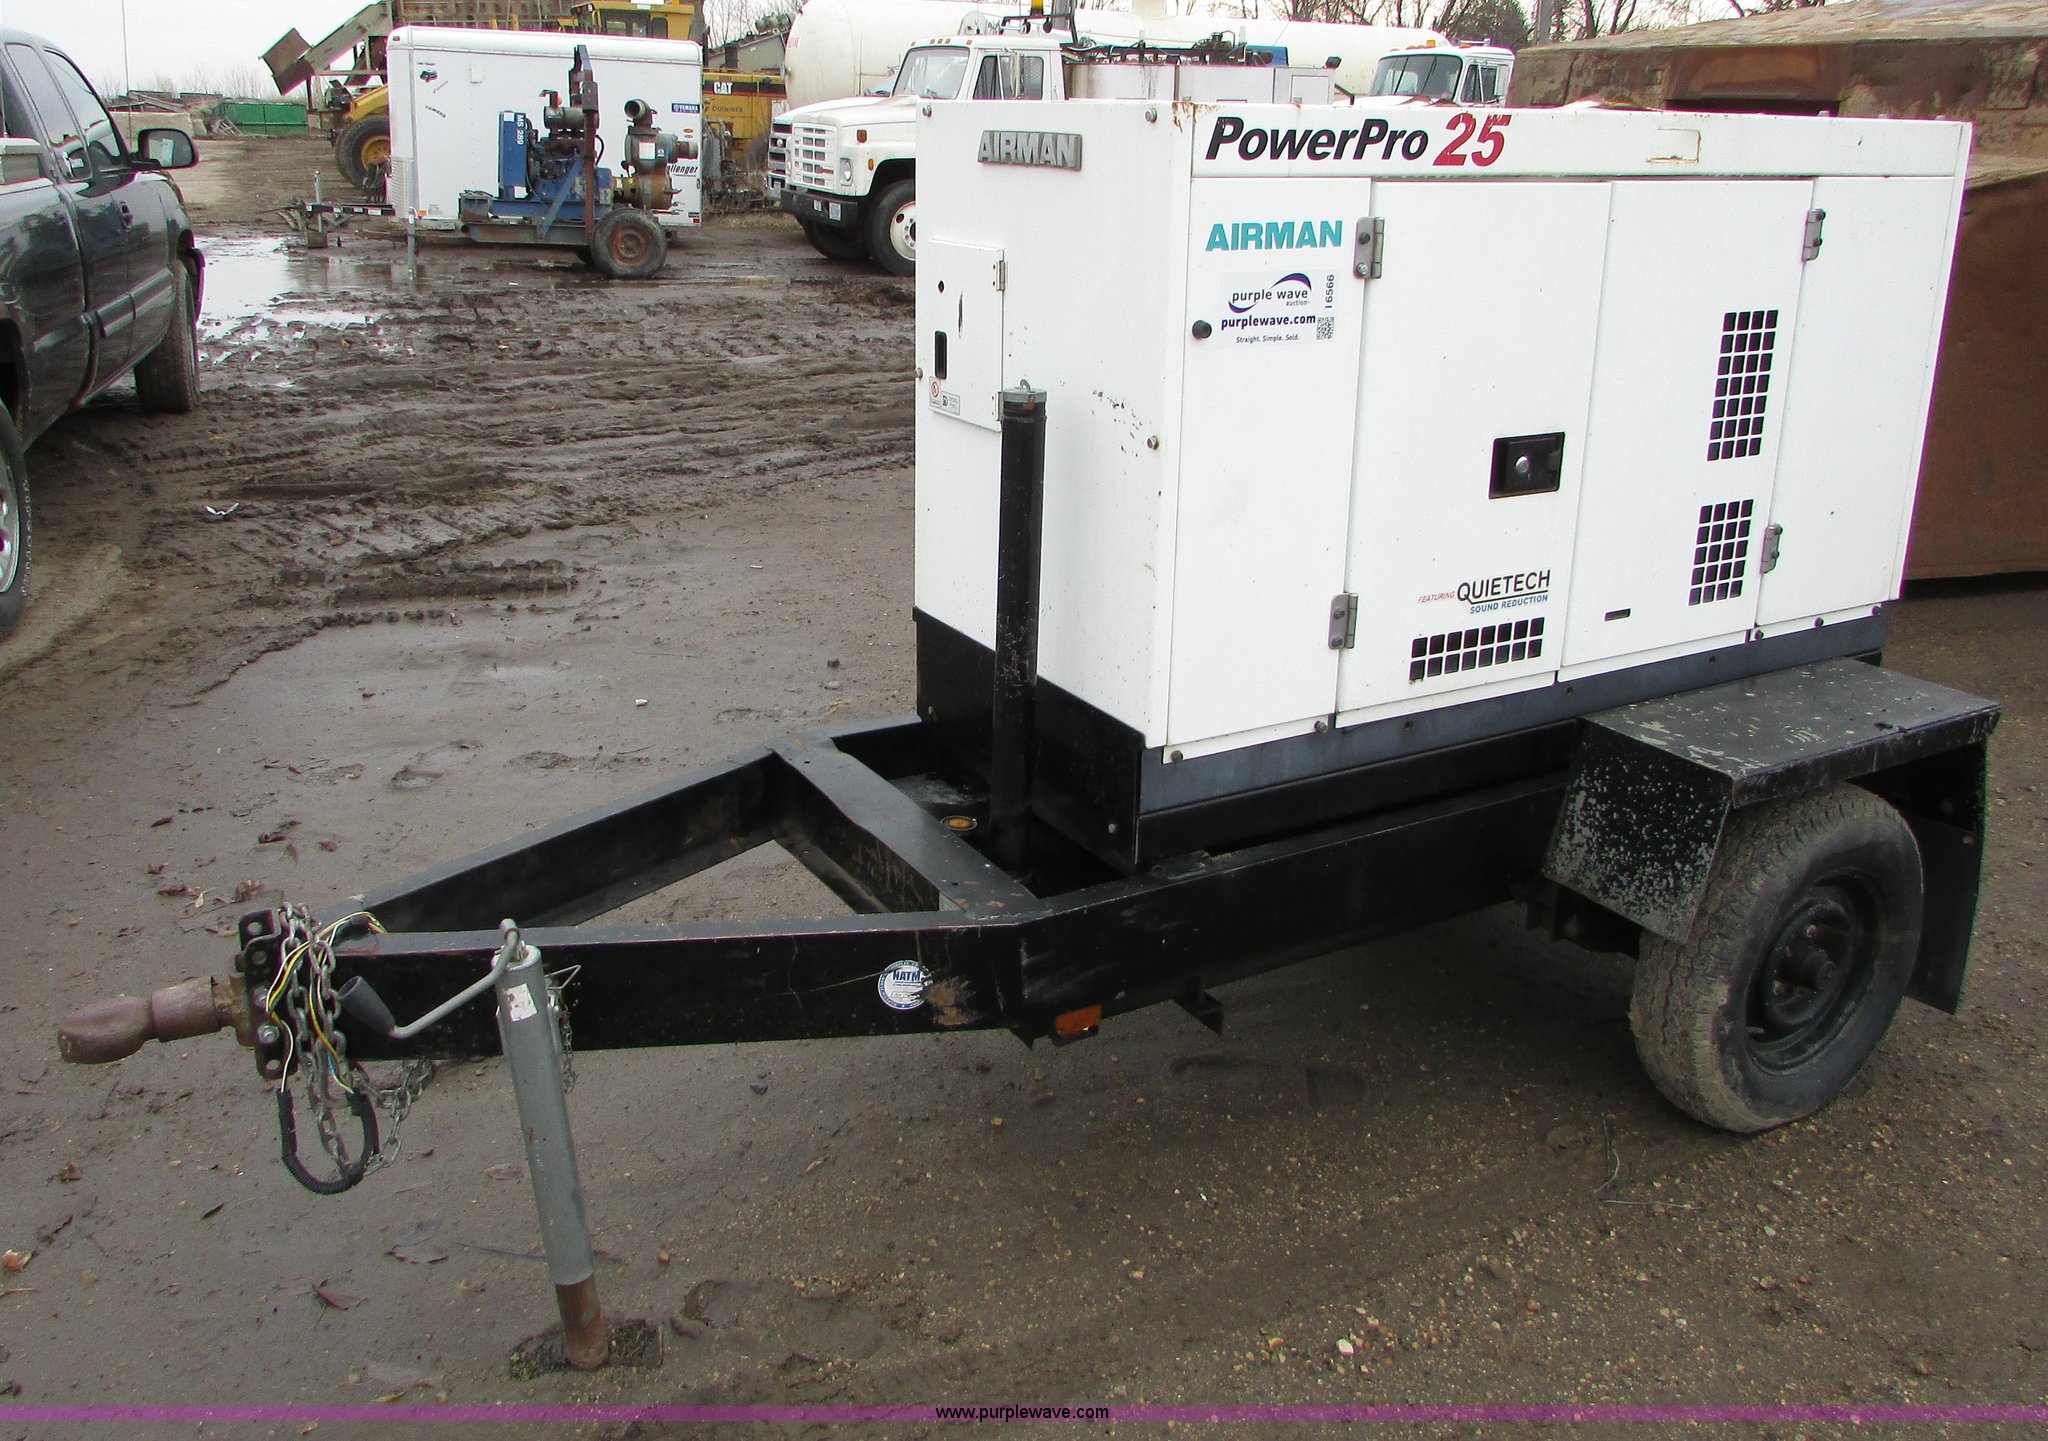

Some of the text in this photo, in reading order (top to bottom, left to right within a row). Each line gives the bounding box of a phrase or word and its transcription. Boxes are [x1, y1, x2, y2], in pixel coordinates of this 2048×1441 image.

[713, 81, 733, 95] CAT
[517, 114, 525, 145] MS 289
[1205, 112, 1512, 167] PowerPro 25
[978, 130, 1078, 169] AIRMAN
[1205, 220, 1343, 252] AIRMAN
[1232, 288, 1308, 304] purple wave
[1324, 274, 1335, 309] 16566
[1221, 313, 1316, 331] purplewave.com
[1235, 333, 1300, 345] Straight. Simple. Sold.
[1417, 569, 1551, 604] FEATURING QUIETECH
[1470, 594, 1548, 615] SOUND REDUCTION
[893, 970, 921, 982] NATM
